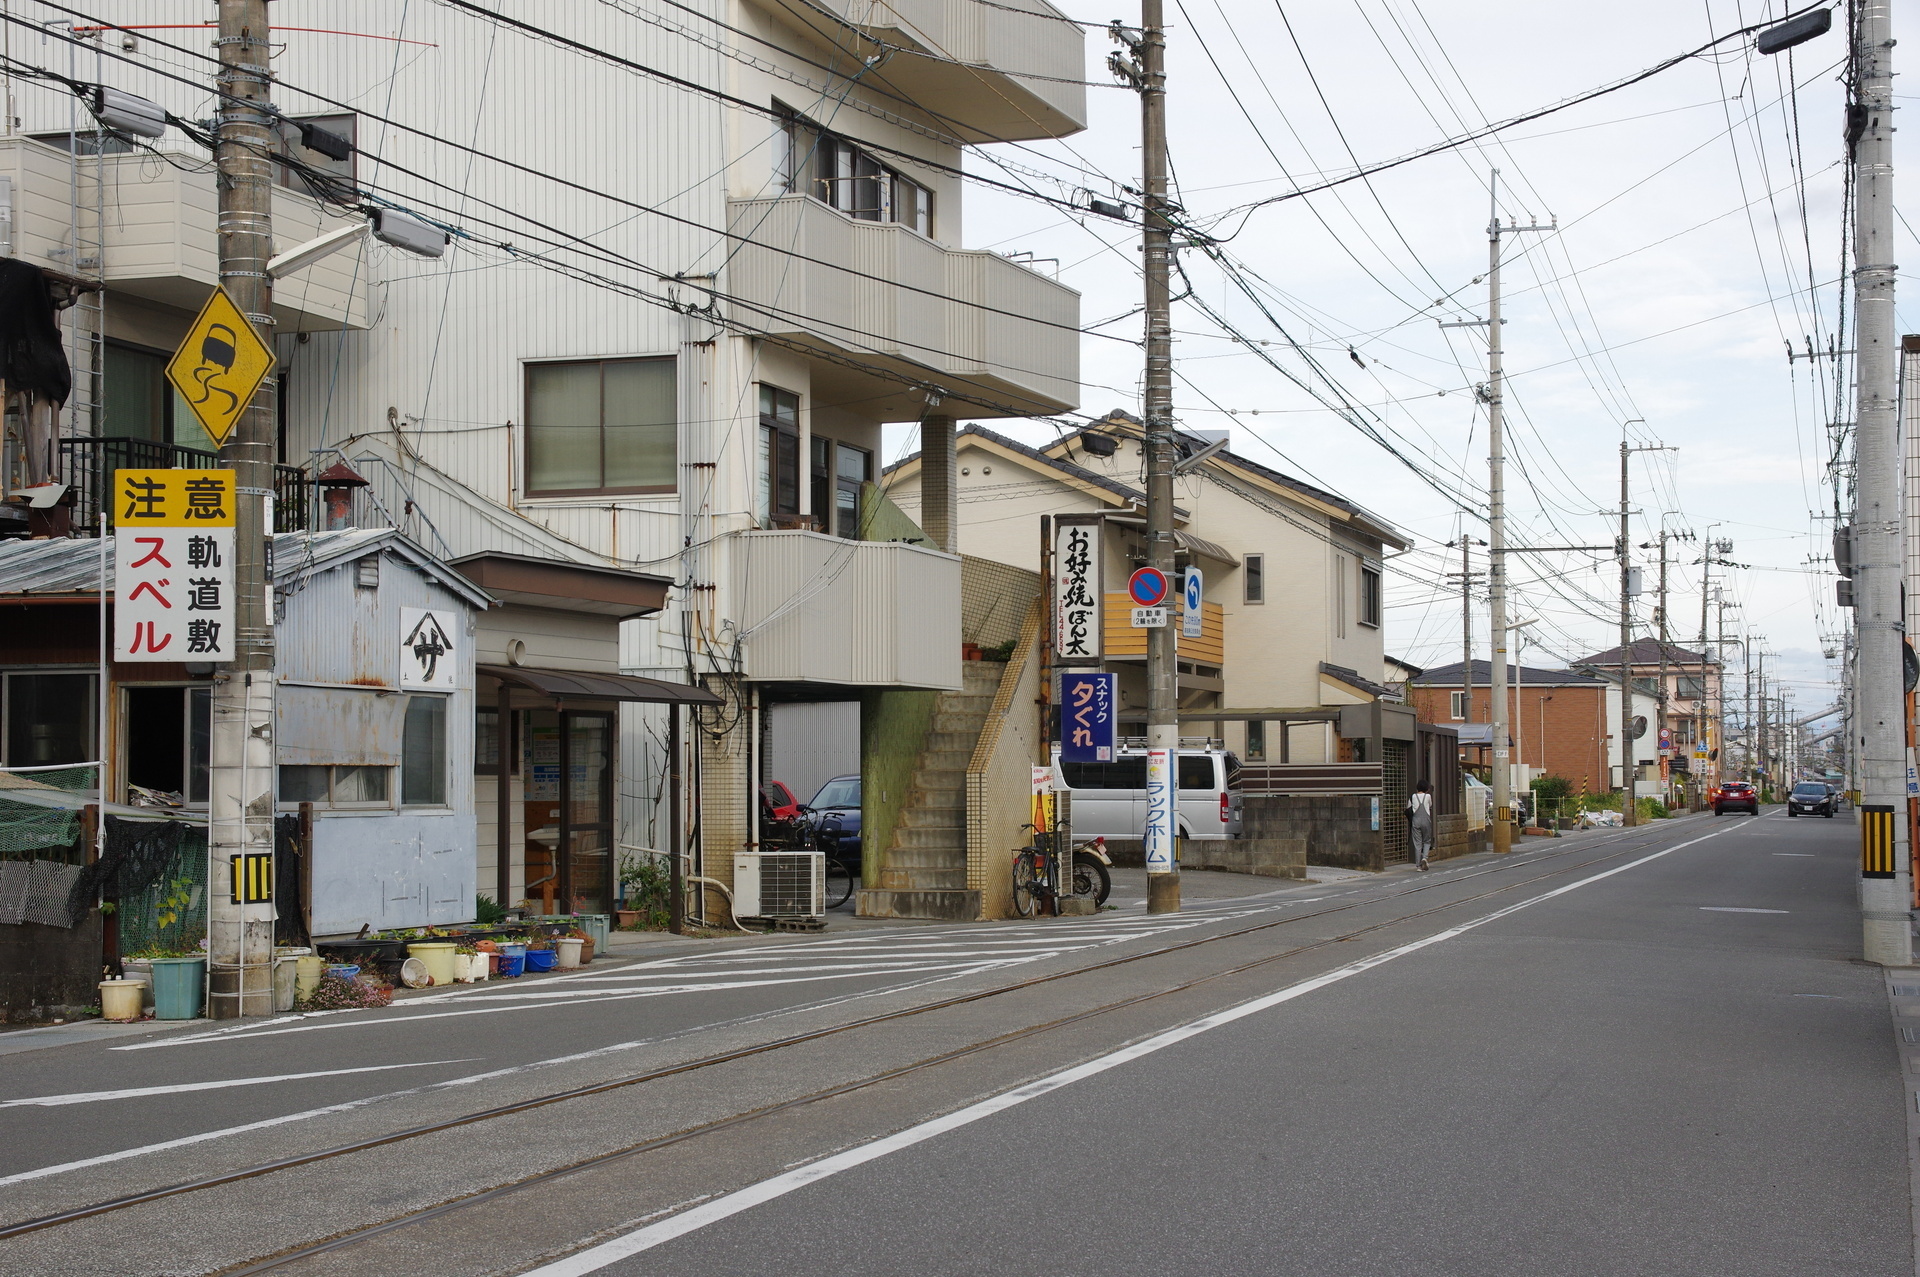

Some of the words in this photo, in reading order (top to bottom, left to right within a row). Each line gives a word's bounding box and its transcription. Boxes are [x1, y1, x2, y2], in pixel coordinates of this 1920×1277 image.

[124, 476, 227, 520] 注意
[129, 537, 172, 654] スベル
[187, 535, 221, 653] 軌道敷
[1064, 527, 1095, 656] お好み焼ぼん太
[1071, 681, 1094, 748] 夕ぐれ
[1096, 677, 1108, 724] スナック
[1147, 781, 1167, 863] ラックホーム
